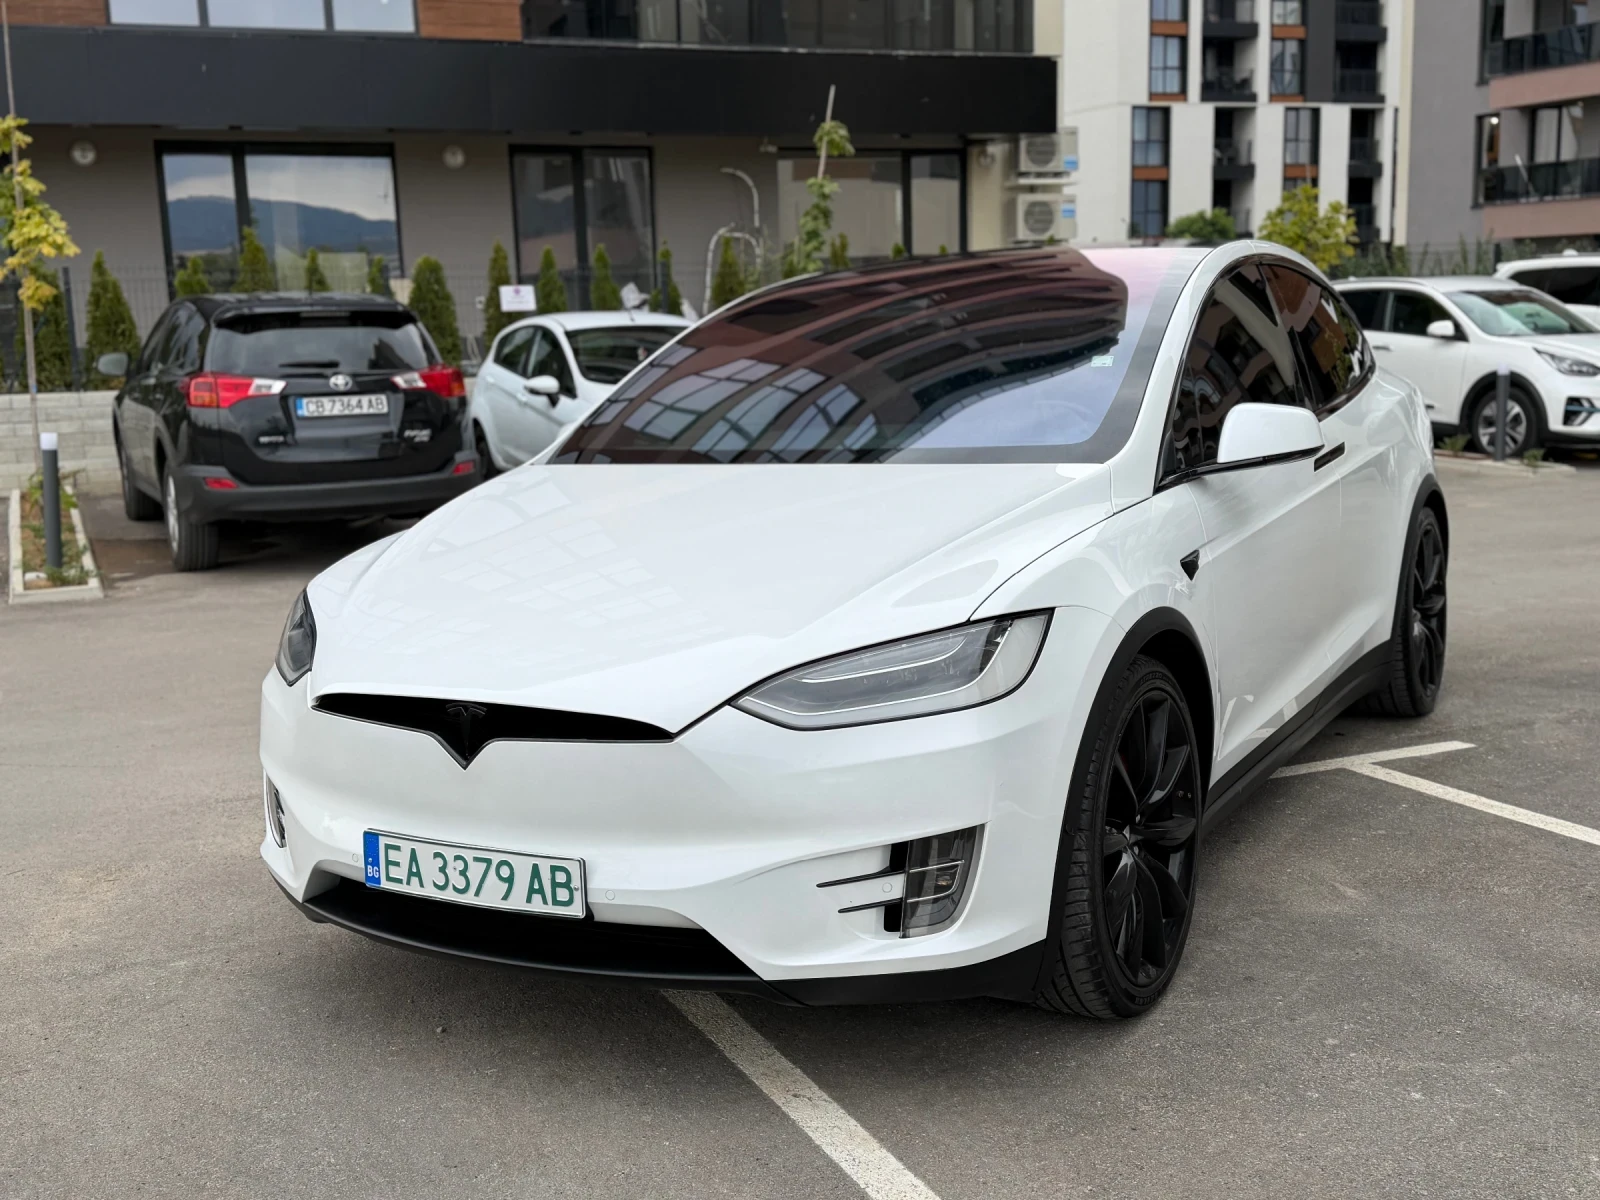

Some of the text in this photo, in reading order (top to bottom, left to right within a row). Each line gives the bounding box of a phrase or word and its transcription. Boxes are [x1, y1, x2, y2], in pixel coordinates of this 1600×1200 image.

[306, 397, 385, 414] CB 7364 AB
[367, 865, 380, 879] BG
[384, 843, 575, 907] EA 3379 AB
